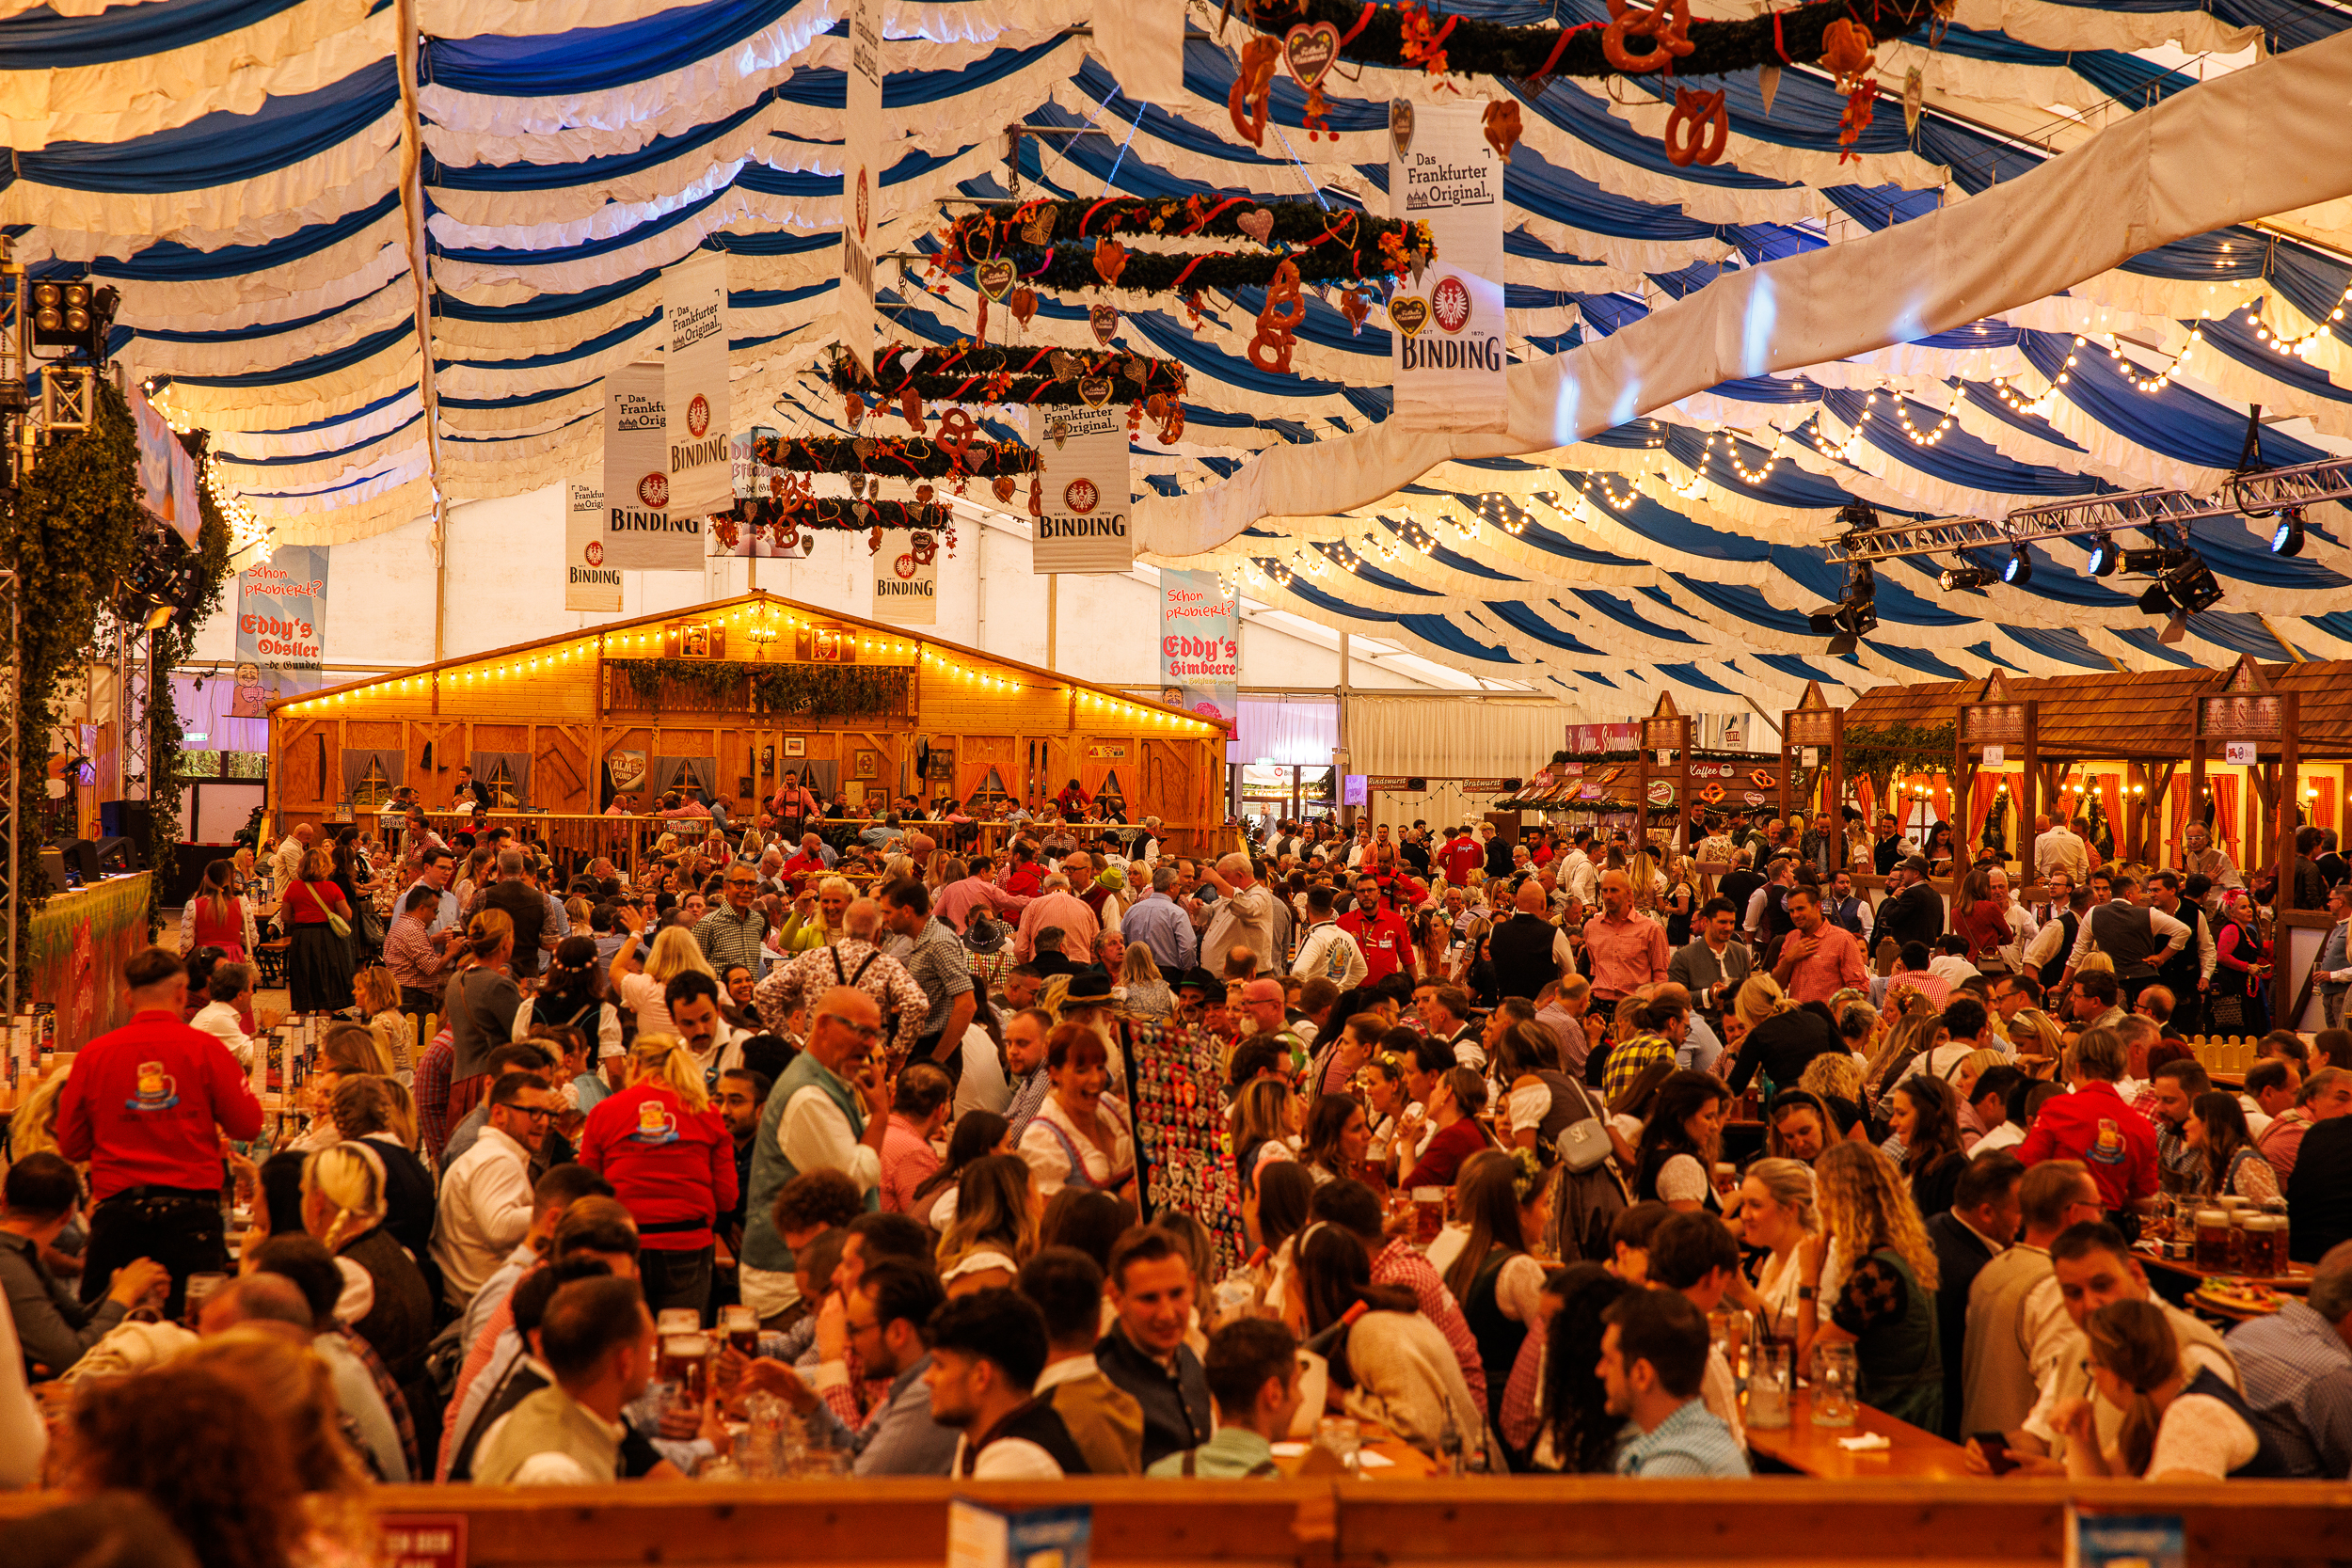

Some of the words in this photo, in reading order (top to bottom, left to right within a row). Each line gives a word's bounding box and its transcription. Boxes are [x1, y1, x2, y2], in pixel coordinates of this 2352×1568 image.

[1416, 153, 1437, 166] Das
[1407, 164, 1487, 184] Frankfurter
[1430, 181, 1490, 204] Original.
[673, 304, 719, 332] Frankfurter
[677, 306, 690, 317] Das
[685, 317, 721, 341] Original.
[1401, 334, 1501, 372] BINDING
[628, 394, 646, 404] Das
[620, 402, 666, 415] Frankfu
[1044, 408, 1113, 423] Frankfurter
[1067, 418, 1116, 435] Original.
[671, 434, 728, 473] BINDING
[575, 490, 604, 499] Frankfu
[585, 500, 604, 511] Origi
[611, 508, 699, 533] BINDING
[1040, 515, 1127, 539] BINDING
[248, 564, 288, 579] Schon
[569, 566, 620, 585] BINDING
[877, 579, 933, 596] BINDING
[1168, 589, 1204, 602] Schon
[258, 639, 319, 657] Obstler
[1169, 660, 1236, 676] Himbeere
[1578, 726, 1600, 754] Kleine
[612, 760, 632, 773] ALM
[1690, 764, 1718, 778] Kaffee
[1368, 777, 1406, 785] Rindswurst
[1464, 779, 1502, 787] Bratwurst
[669, 821, 692, 833] Alm
[693, 822, 700, 832] 2
[1658, 814, 1680, 827] Kaff
[1326, 937, 1343, 958] SECURITY
[1344, 939, 1353, 958] TEAM
